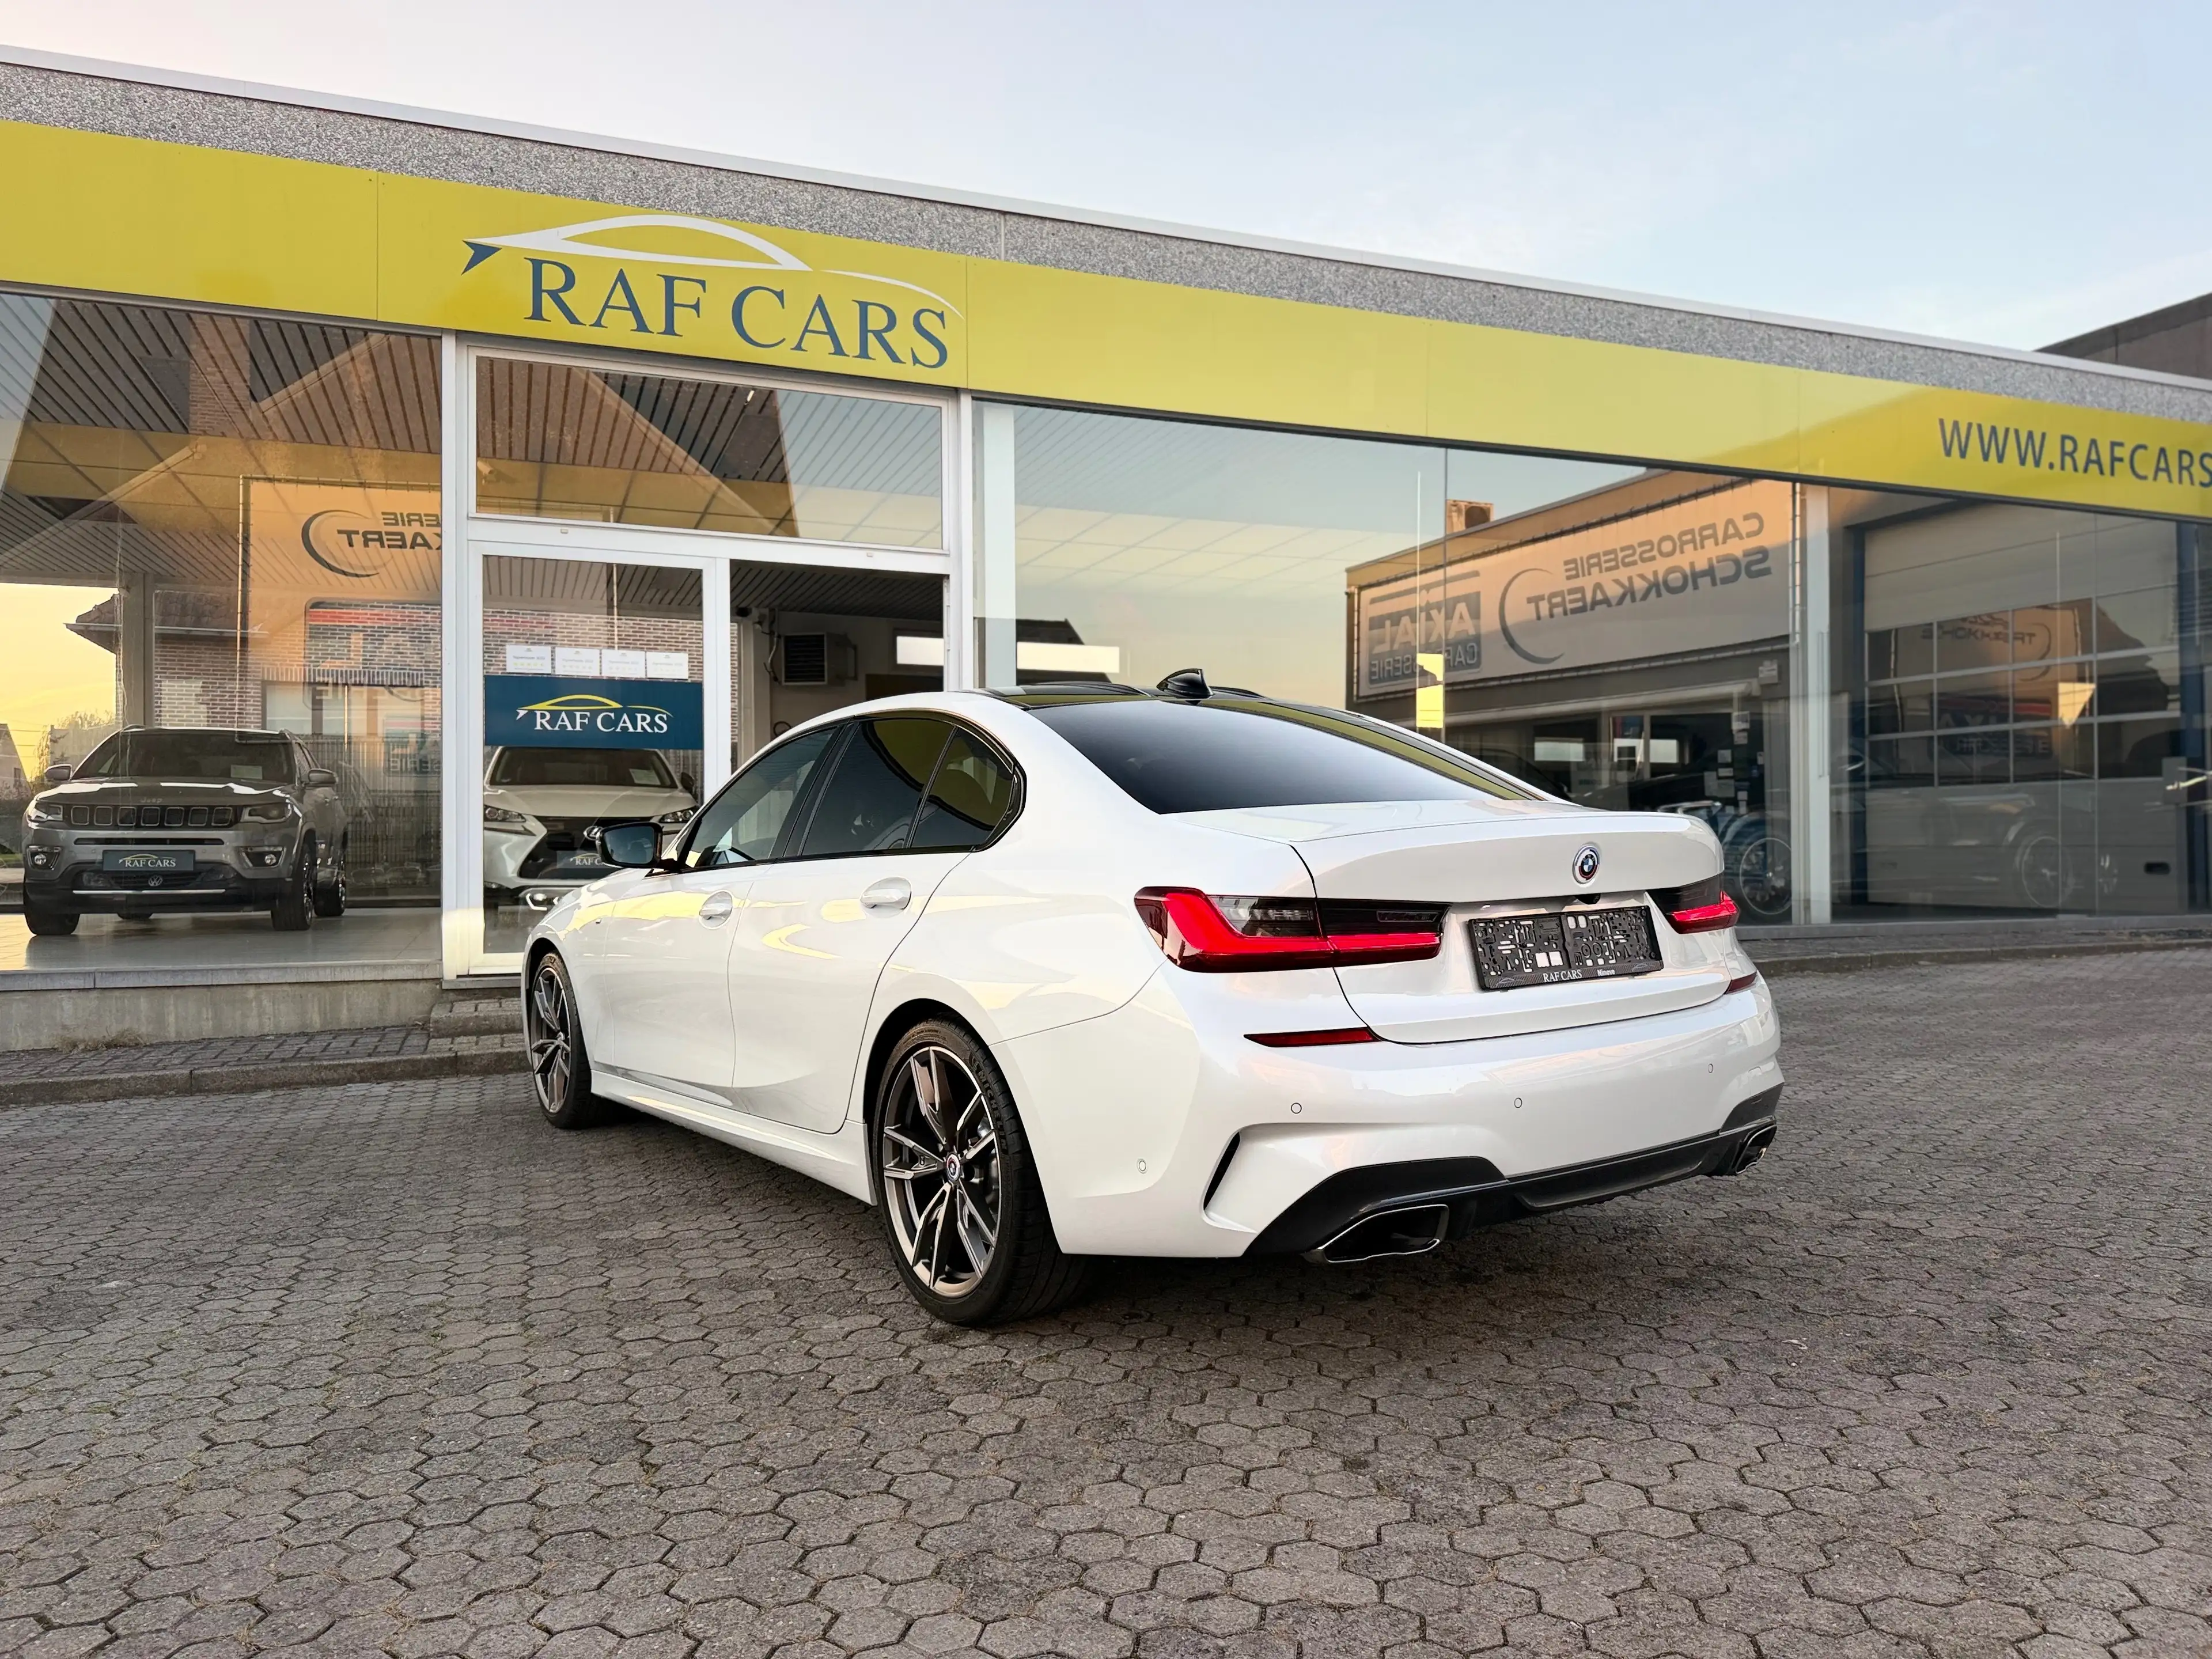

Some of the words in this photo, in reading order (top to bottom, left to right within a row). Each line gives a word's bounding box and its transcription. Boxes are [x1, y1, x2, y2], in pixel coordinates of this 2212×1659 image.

[524, 256, 707, 338] RAF
[731, 285, 949, 369] CARS
[1938, 418, 2212, 488] WWW.RAFCARS
[534, 710, 590, 731] RAF
[596, 711, 668, 733] CARS
[125, 859, 146, 868] RAF
[147, 859, 176, 868] CARS
[575, 858, 593, 866] RAF
[1543, 971, 1560, 983] RAF
[1560, 969, 1582, 980] CARS
